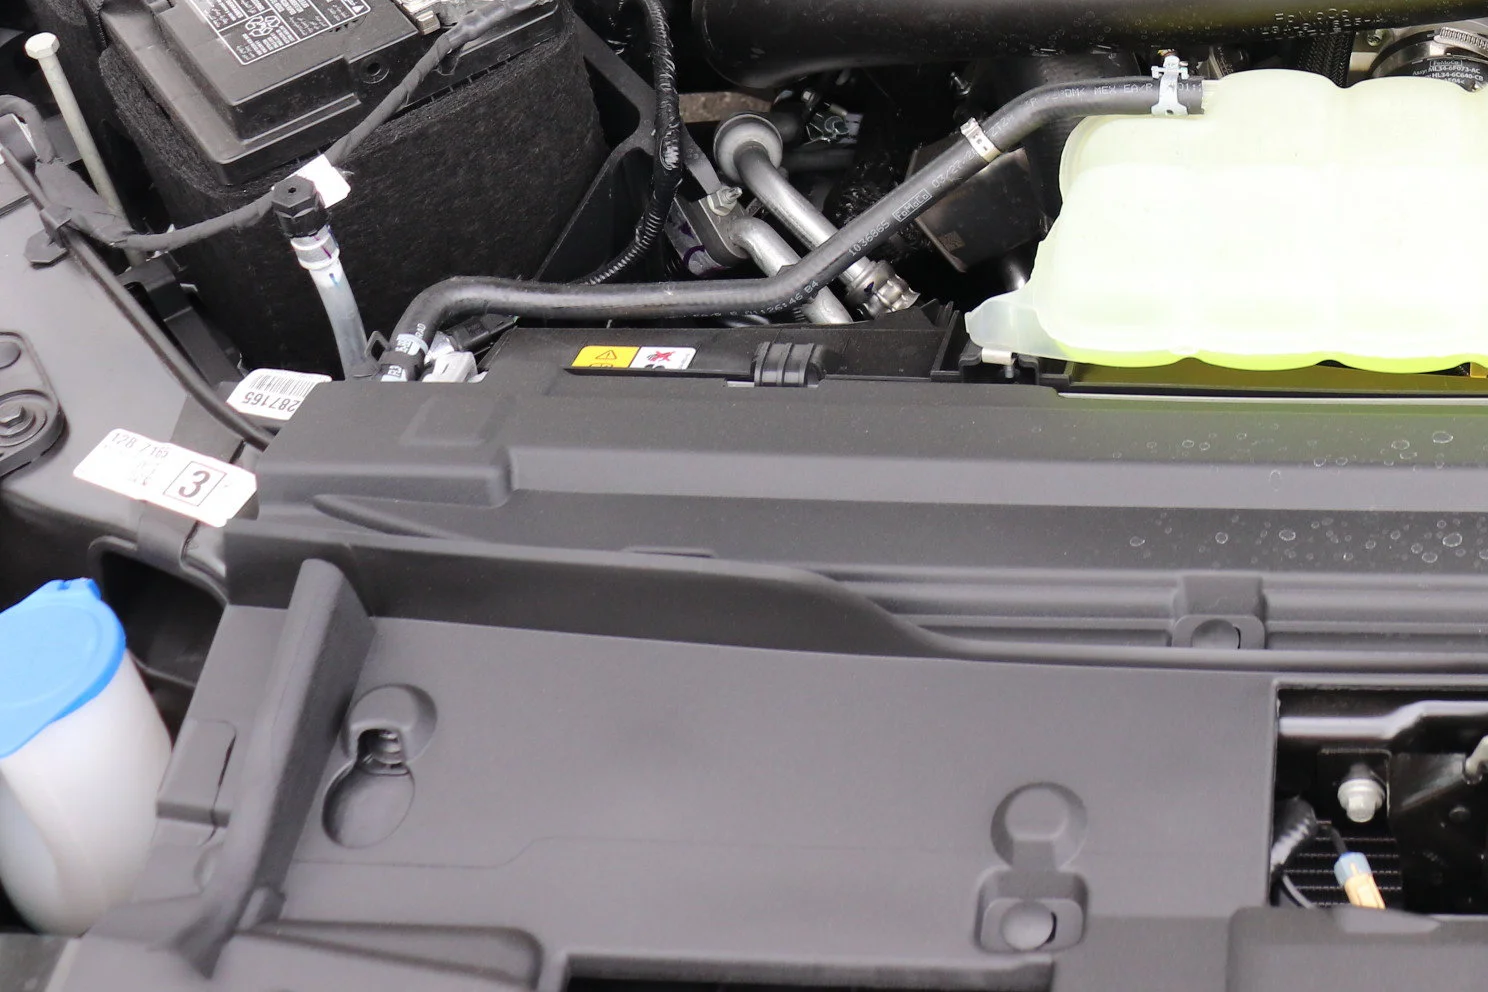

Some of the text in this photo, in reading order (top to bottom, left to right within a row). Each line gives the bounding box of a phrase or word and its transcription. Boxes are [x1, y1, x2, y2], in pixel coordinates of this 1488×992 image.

[847, 219, 890, 257] 1036865
[894, 190, 932, 222] FoMoCo
[1094, 86, 1116, 95] MEX
[803, 278, 819, 295] B4
[178, 470, 211, 498] 3
